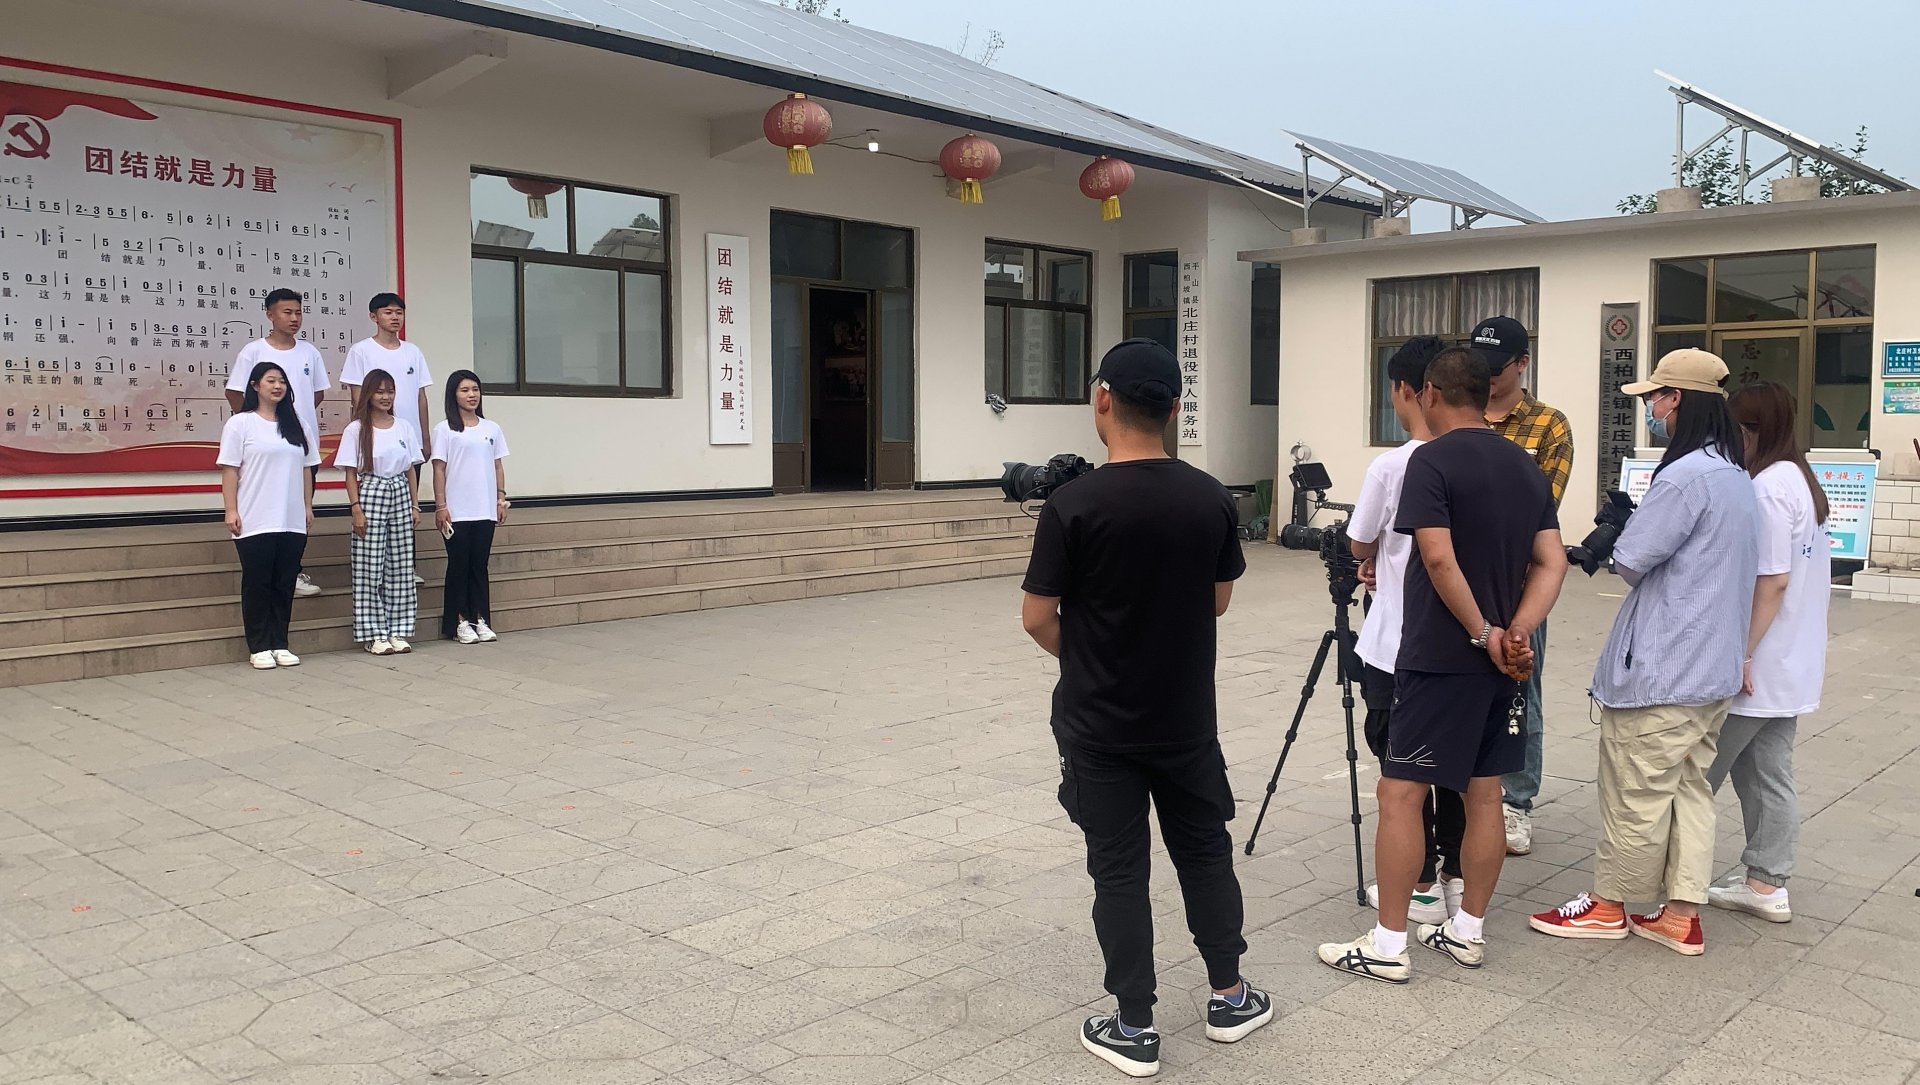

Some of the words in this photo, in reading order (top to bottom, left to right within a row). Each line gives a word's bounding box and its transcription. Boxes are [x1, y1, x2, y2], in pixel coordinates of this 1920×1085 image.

[85, 146, 277, 193] 团结就是力量
[1183, 262, 1191, 305] 西柏坡镇
[1191, 262, 1199, 304] 平山县
[717, 247, 734, 410] 团结就是力量
[1182, 307, 1199, 439] 北庄村退役军人服务站
